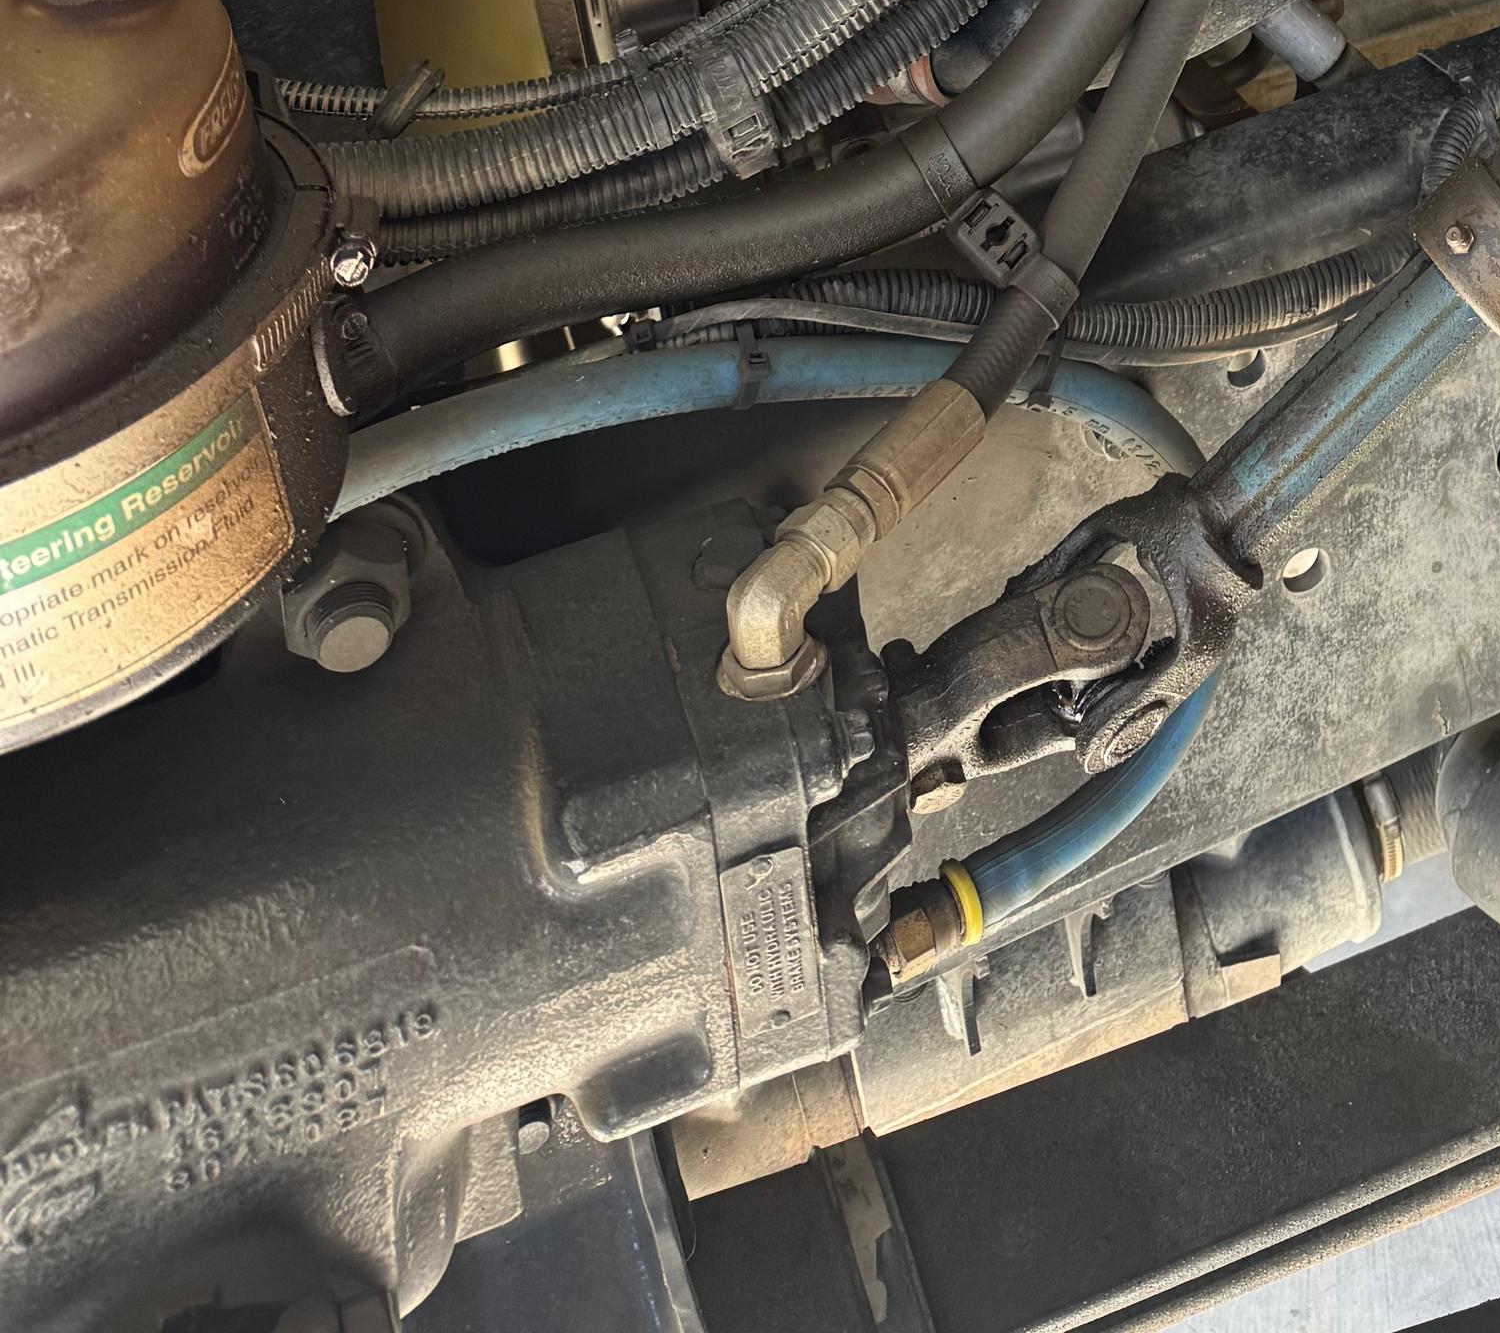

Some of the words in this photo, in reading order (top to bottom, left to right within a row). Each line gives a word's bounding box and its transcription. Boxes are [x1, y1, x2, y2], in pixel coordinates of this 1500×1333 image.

[120, 416, 245, 521] Reservoir
[62, 537, 208, 632] Transmission
[209, 496, 256, 543] Fluid
[90, 543, 150, 591] mark
[153, 525, 182, 552] on
[740, 910, 757, 941] USE
[750, 976, 764, 995] DO
